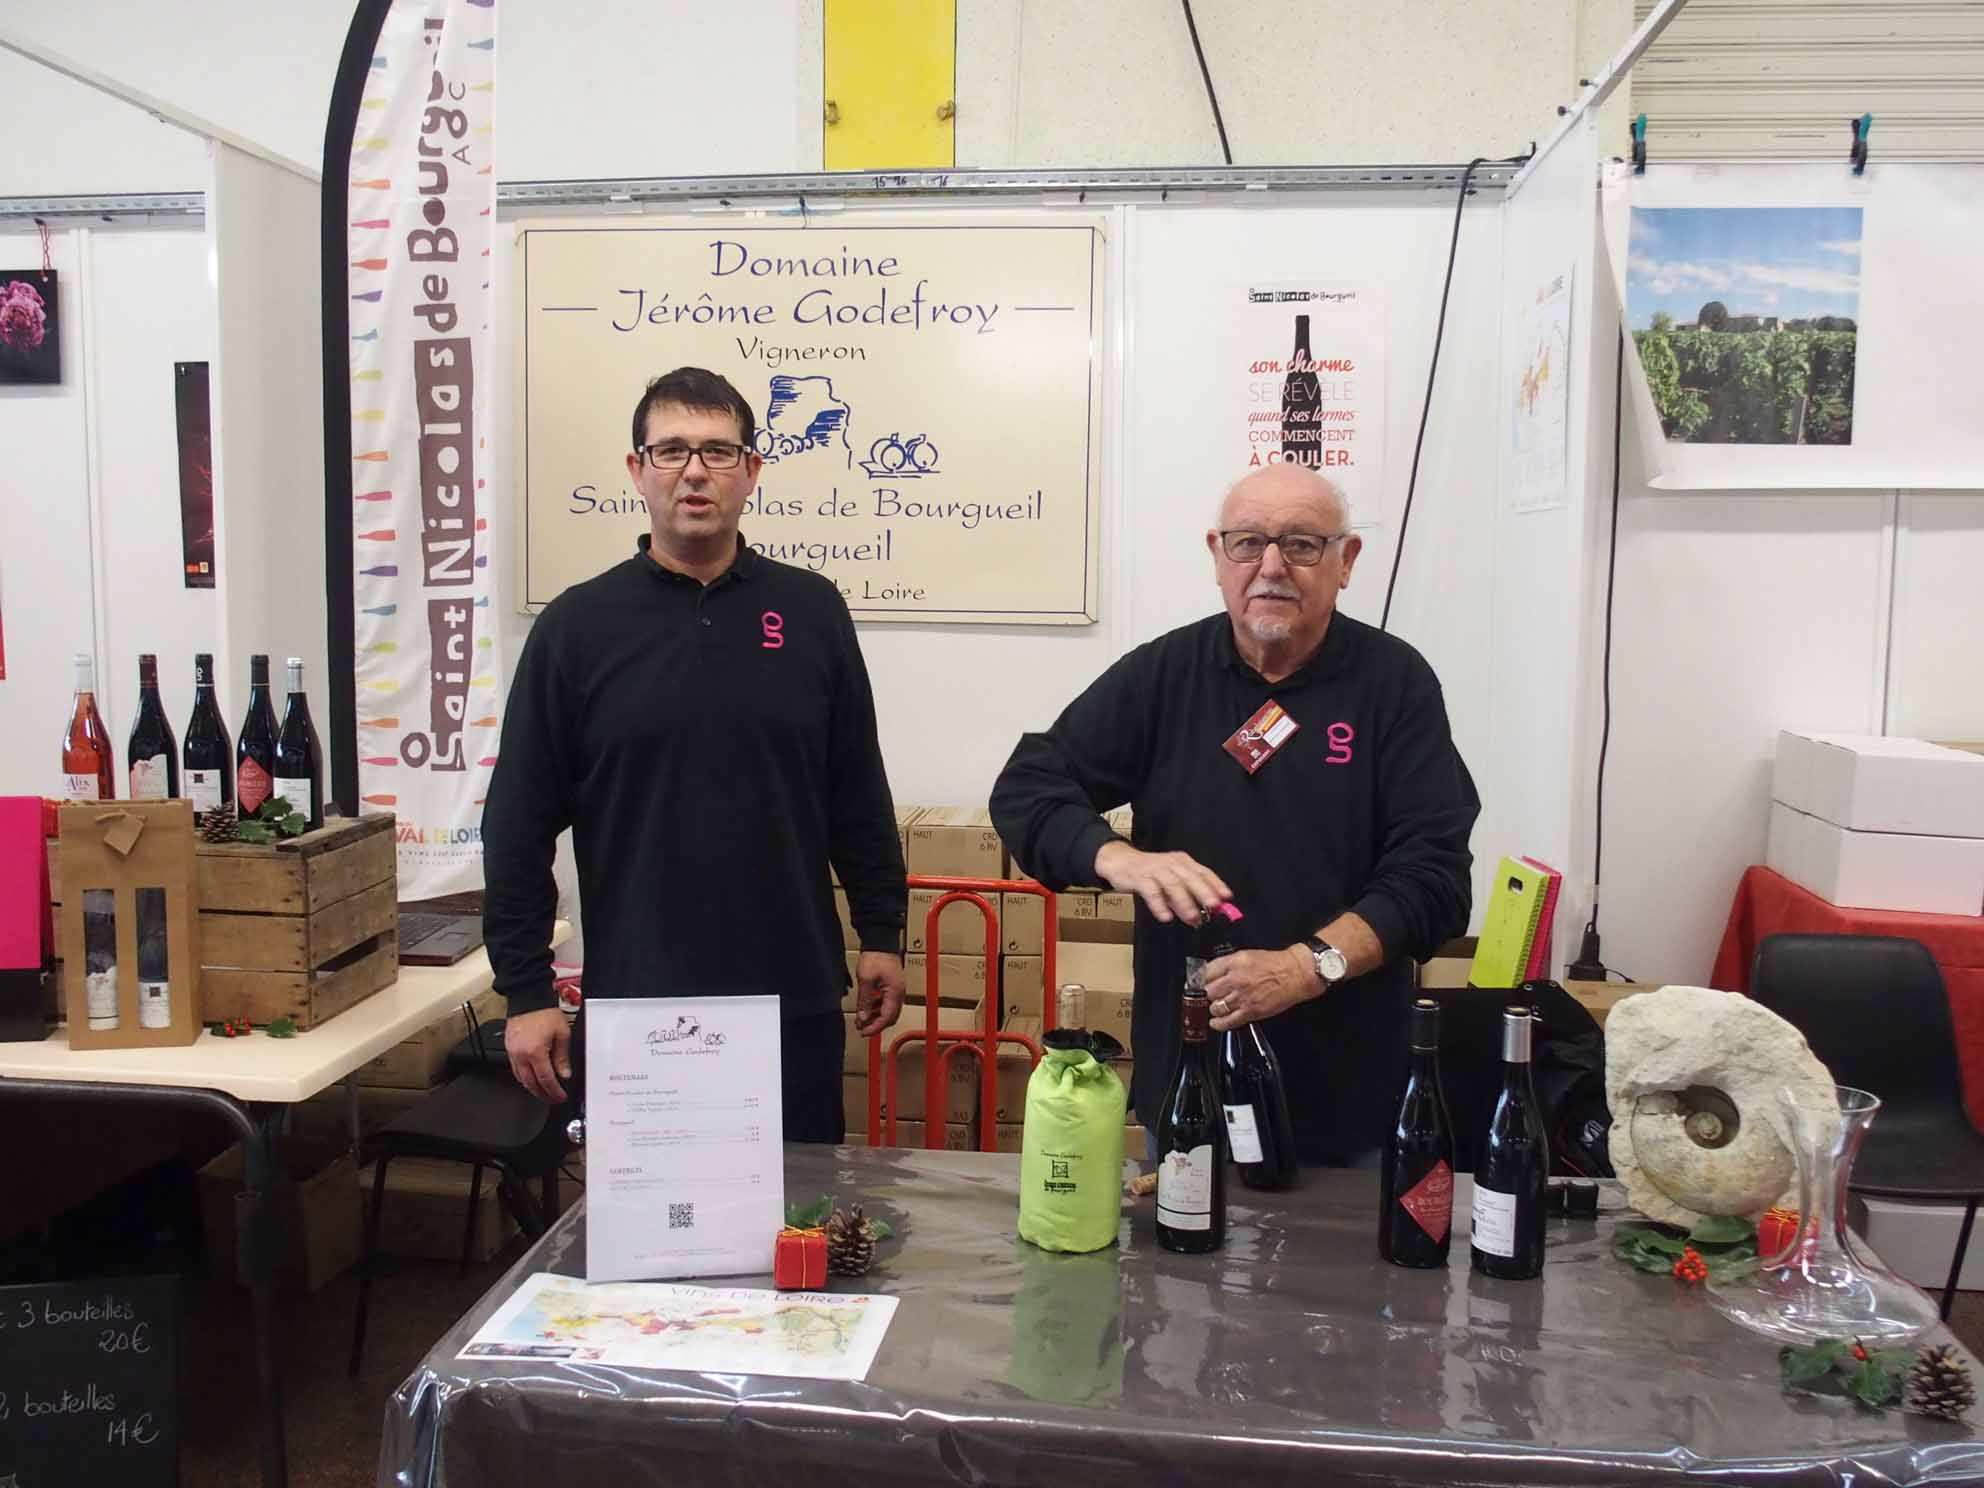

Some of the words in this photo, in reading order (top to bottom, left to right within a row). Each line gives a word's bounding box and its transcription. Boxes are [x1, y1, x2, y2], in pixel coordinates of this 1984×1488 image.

[709, 240, 901, 278] Domaine
[413, 273, 459, 333] de
[612, 287, 777, 332] Jérôme
[792, 280, 999, 334] Godefroy
[735, 336, 867, 368] Vigneron
[1248, 359, 1282, 374] son
[1286, 348, 1355, 374] charme
[1249, 382, 1273, 402] SE
[1248, 406, 1290, 427] quand
[1291, 410, 1310, 423] ses
[1311, 406, 1356, 423] larmes
[1248, 429, 1355, 442] COMMENCENT
[423, 343, 474, 584] Nicolas
[1249, 445, 1262, 466] À
[1267, 449, 1355, 467] COULER.
[569, 485, 648, 515] Sain
[740, 487, 803, 517] olas
[817, 487, 859, 518] de
[872, 486, 1042, 528] Bourgueil
[748, 528, 892, 571] ourgueil
[863, 579, 926, 601] Loire
[401, 601, 471, 771] Saint
[451, 827, 481, 844] LOIR
[913, 830, 933, 840] HAUT
[913, 895, 933, 904] HAUT
[1008, 897, 1027, 905] HAUT
[1103, 897, 1122, 906] HAUT
[1008, 961, 1028, 970] HAUT
[18, 1300, 35, 1329] 3
[44, 1295, 136, 1325] bouteilles
[98, 1321, 152, 1353] 20€
[24, 1383, 117, 1417] bouteilles
[107, 1412, 161, 1447] 14€
